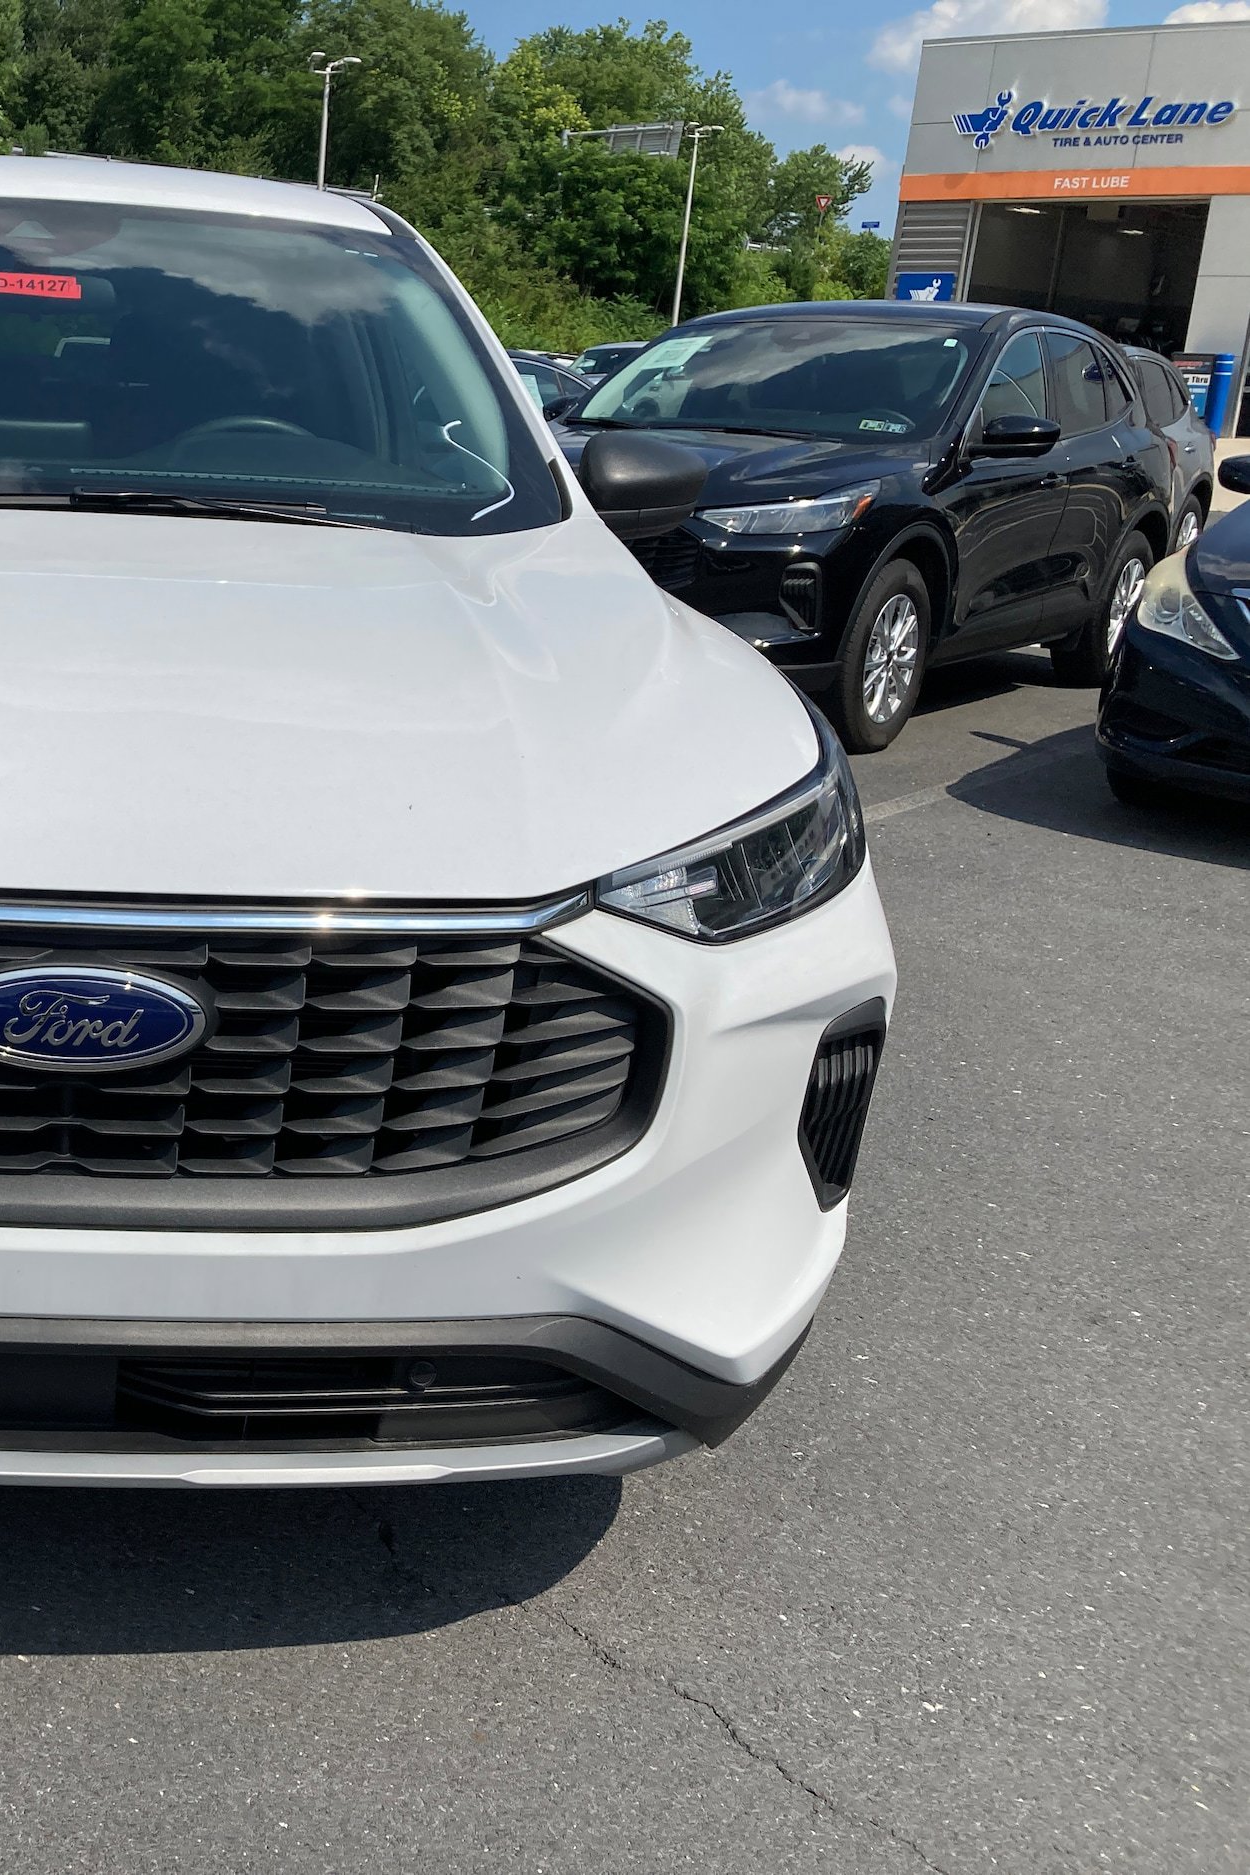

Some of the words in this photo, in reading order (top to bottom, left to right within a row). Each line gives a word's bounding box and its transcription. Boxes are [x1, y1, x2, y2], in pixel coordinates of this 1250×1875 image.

[1011, 97, 1127, 135] Quick
[1126, 96, 1234, 126] Lane
[1053, 137, 1080, 148] TIRE
[1084, 136, 1092, 147] &
[1094, 135, 1129, 146] AUTO
[1132, 133, 1183, 145] CENTER
[1054, 177, 1088, 189] FAST
[1091, 176, 1130, 188] LUBE
[3, 989, 144, 1047] Ford
